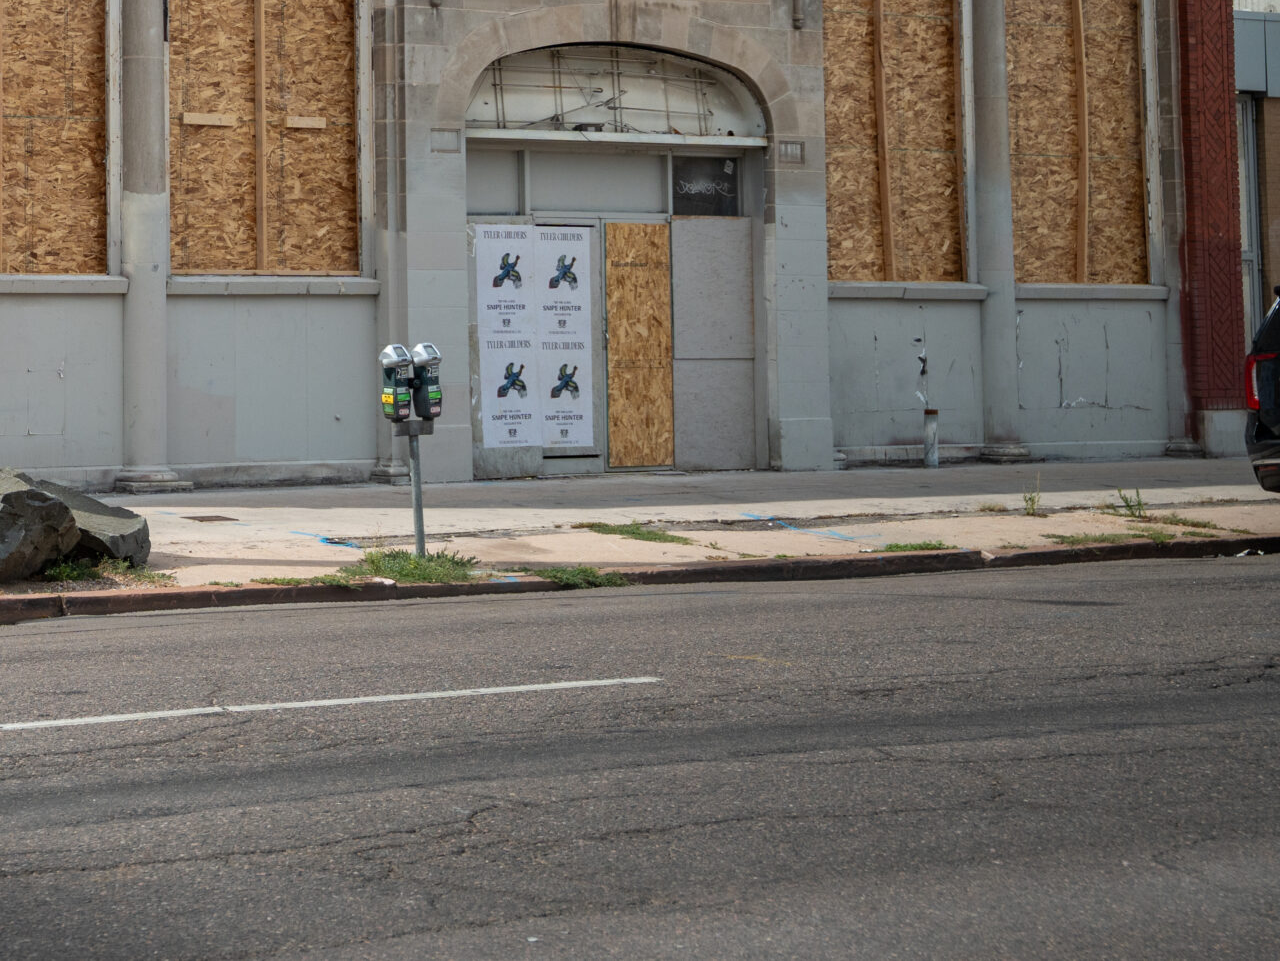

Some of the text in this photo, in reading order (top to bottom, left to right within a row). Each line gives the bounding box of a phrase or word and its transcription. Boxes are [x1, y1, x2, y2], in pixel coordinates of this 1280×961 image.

[483, 231, 527, 239] TYLER CHILDERS
[540, 233, 583, 241] TYLER CHILDERS
[486, 340, 531, 349] TYLER CHILDERS
[542, 342, 585, 350] TYLER CHILDERS
